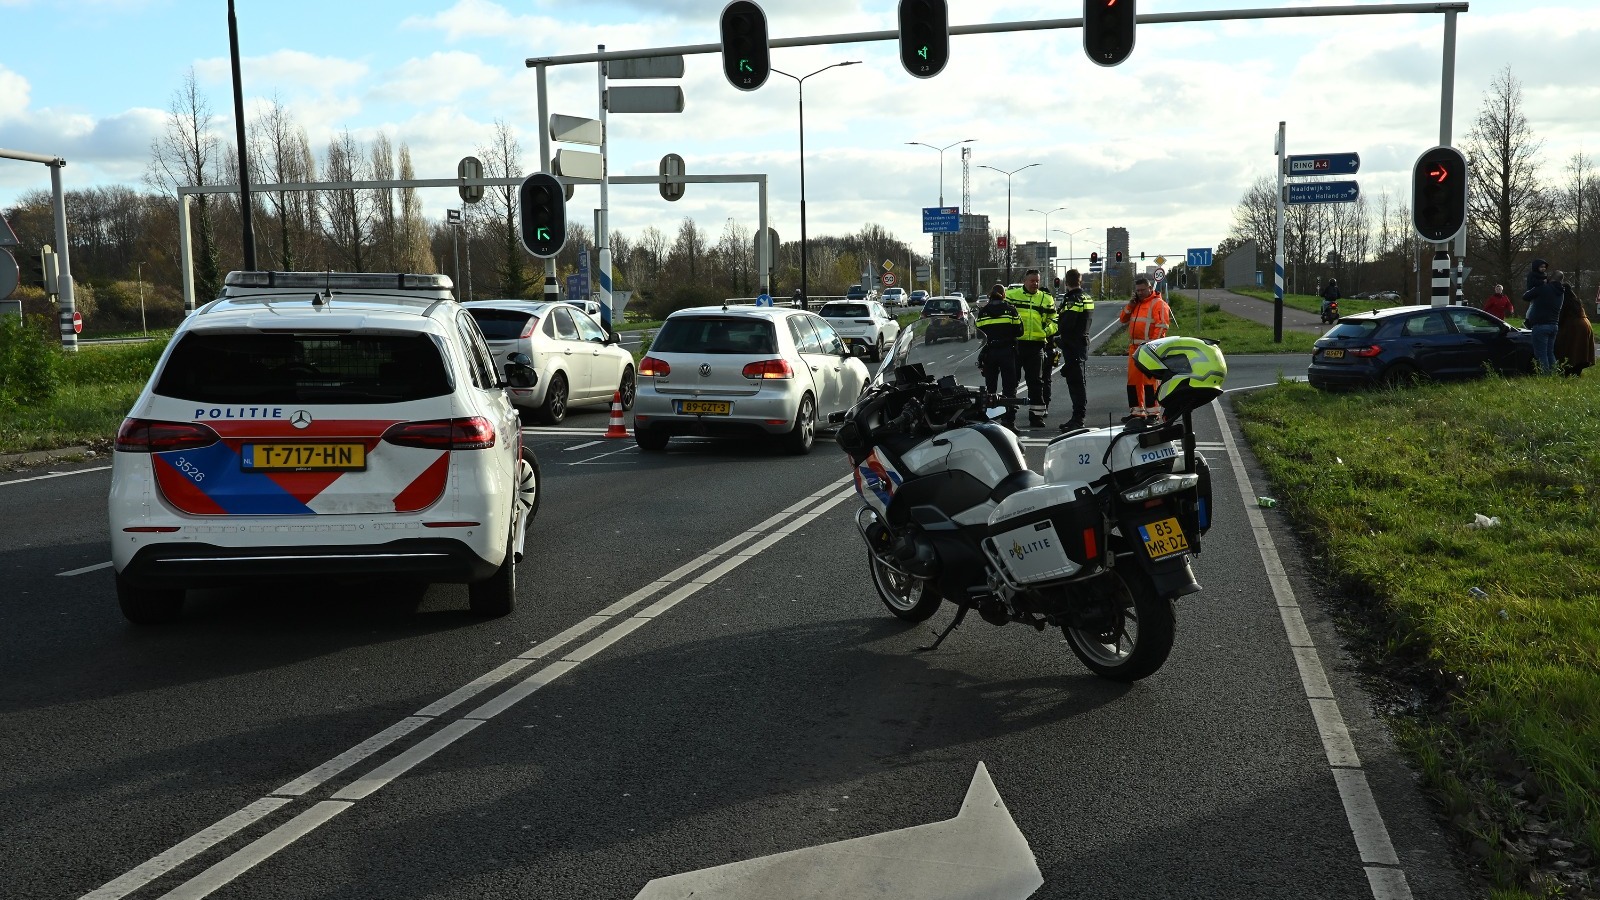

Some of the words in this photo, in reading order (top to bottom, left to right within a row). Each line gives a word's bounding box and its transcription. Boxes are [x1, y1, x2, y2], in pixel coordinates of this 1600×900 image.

[1291, 185, 1324, 193] Naaldwijk
[194, 407, 282, 419] POLITIE
[686, 402, 726, 412] 89-GZT-3
[262, 447, 352, 465] T-717-HN
[1078, 453, 1091, 465] 32
[1141, 447, 1176, 462] POLITIE
[175, 456, 205, 482] 3526
[1154, 521, 1173, 537] 85
[1148, 534, 1187, 556] MR-DZ
